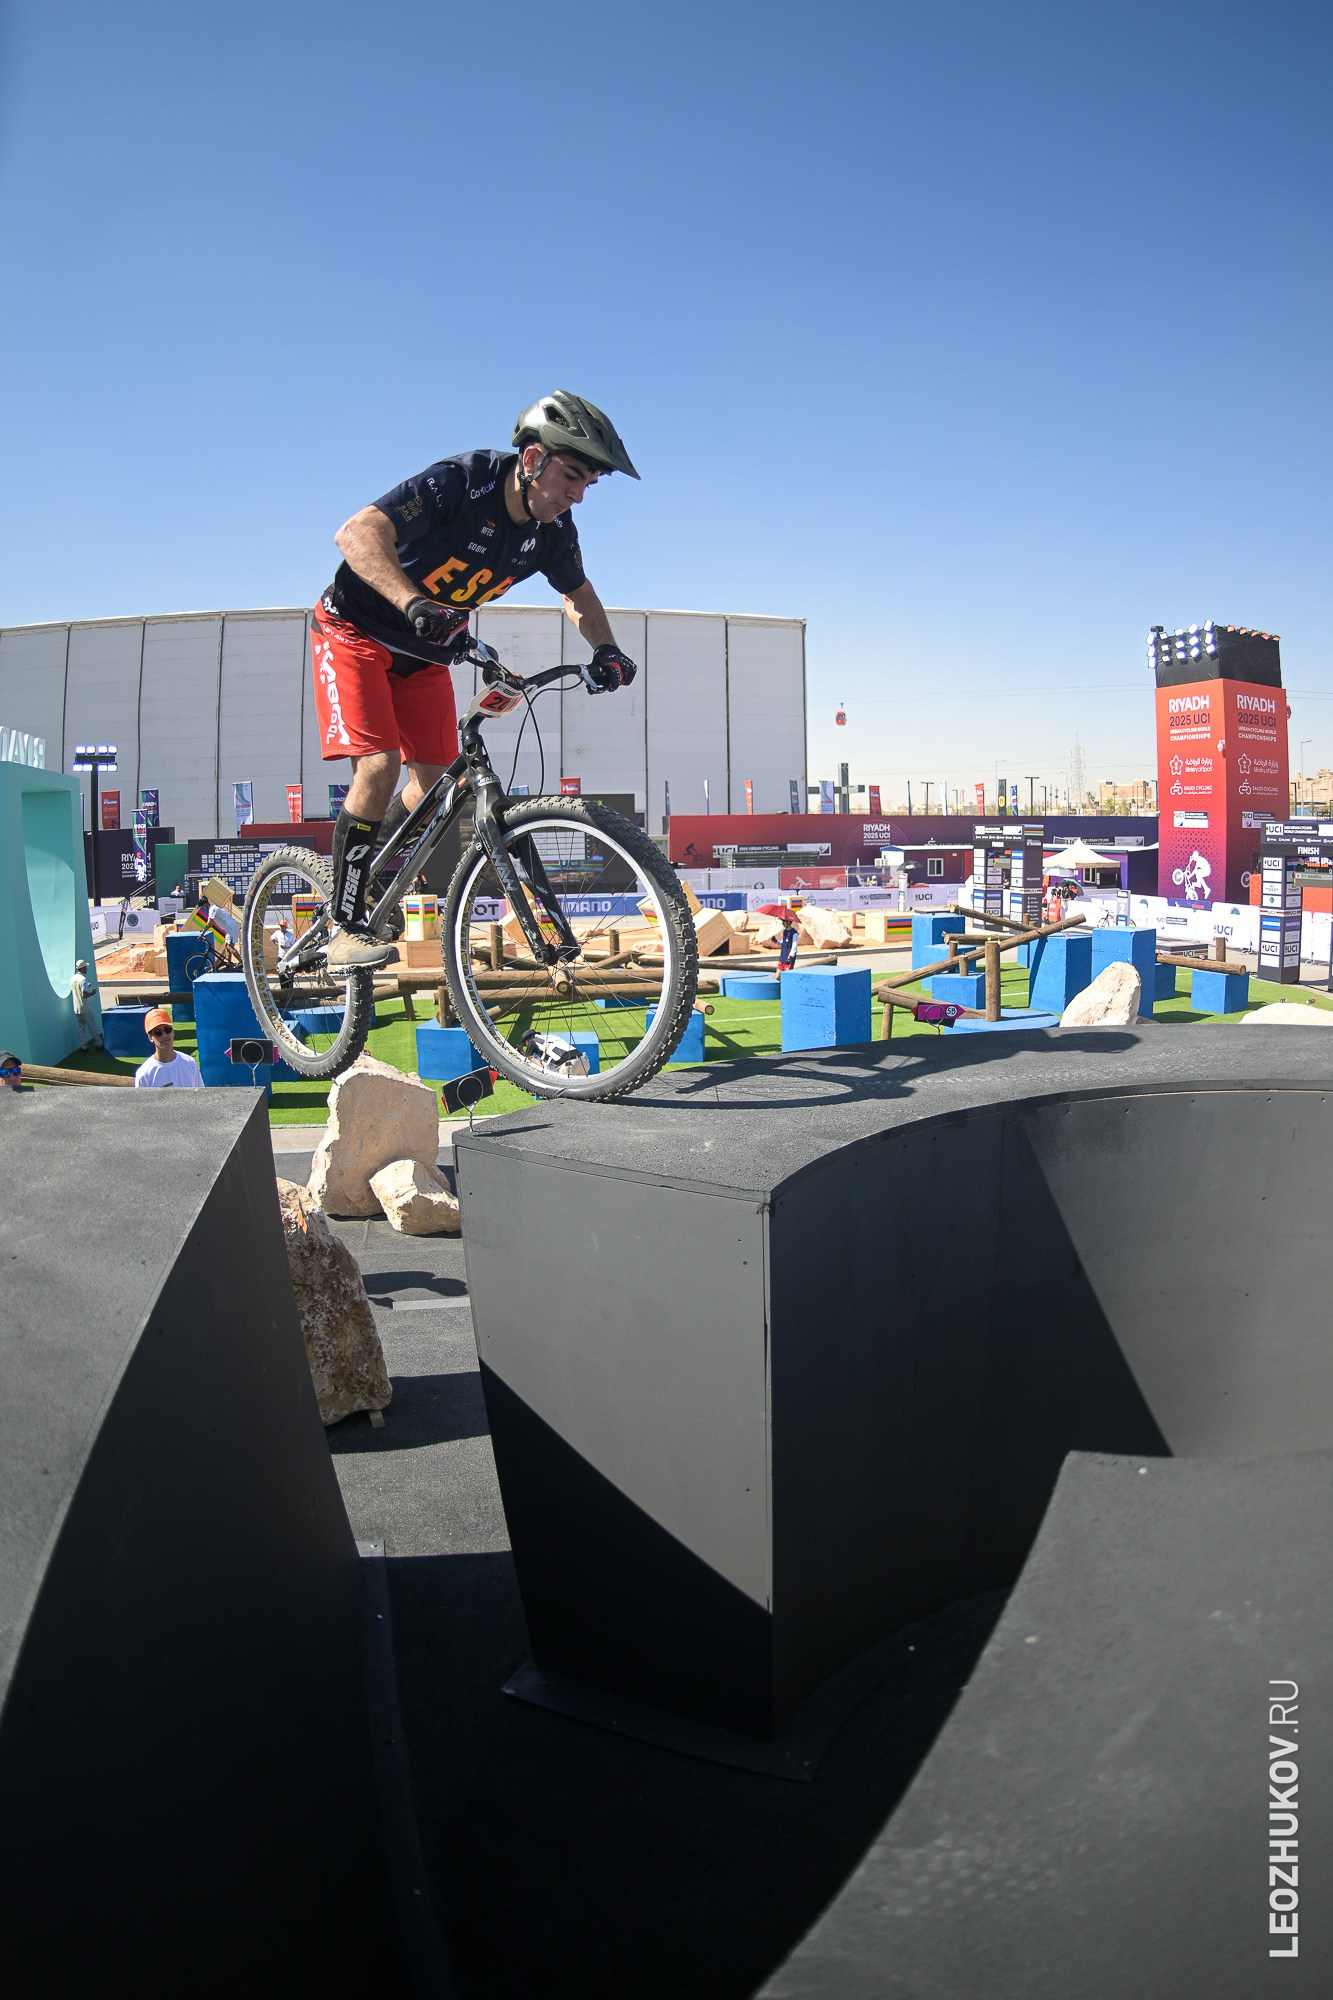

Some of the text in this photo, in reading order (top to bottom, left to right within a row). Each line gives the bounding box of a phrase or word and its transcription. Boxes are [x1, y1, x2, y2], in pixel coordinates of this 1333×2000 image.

[422, 556, 516, 606] ESP
[1169, 695, 1210, 713] RIYADH
[1237, 694, 1275, 713] RIYADH
[1170, 713, 1210, 726] 2025 UCI
[1238, 712, 1276, 727] 2025 UCI
[1170, 733, 1211, 742] CHAMPIONSHIPS
[1238, 733, 1277, 742] CHAMPIONSHIPS
[1298, 847, 1320, 855] FINISH
[1120, 904, 1125, 913] 2
[1217, 925, 1233, 936] UCI
